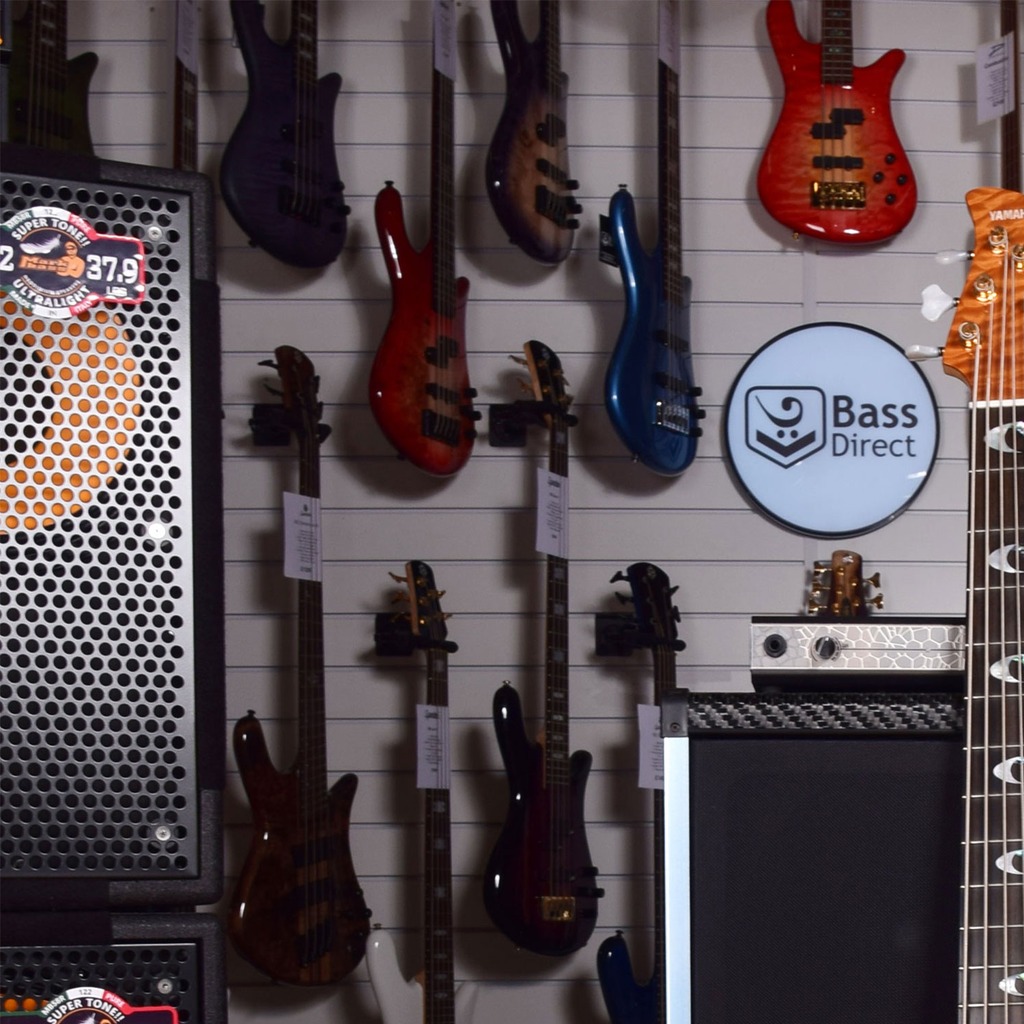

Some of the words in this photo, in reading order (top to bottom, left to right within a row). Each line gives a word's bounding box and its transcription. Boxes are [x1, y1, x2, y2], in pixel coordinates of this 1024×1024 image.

[11, 218, 48, 241] SUPER
[51, 218, 91, 247] TONE!!
[86, 254, 138, 284] 37.9
[13, 278, 90, 307] ULTRALIGHT
[832, 395, 918, 428] Bass
[832, 433, 916, 457] Direct
[85, 998, 125, 1022] TONE!!
